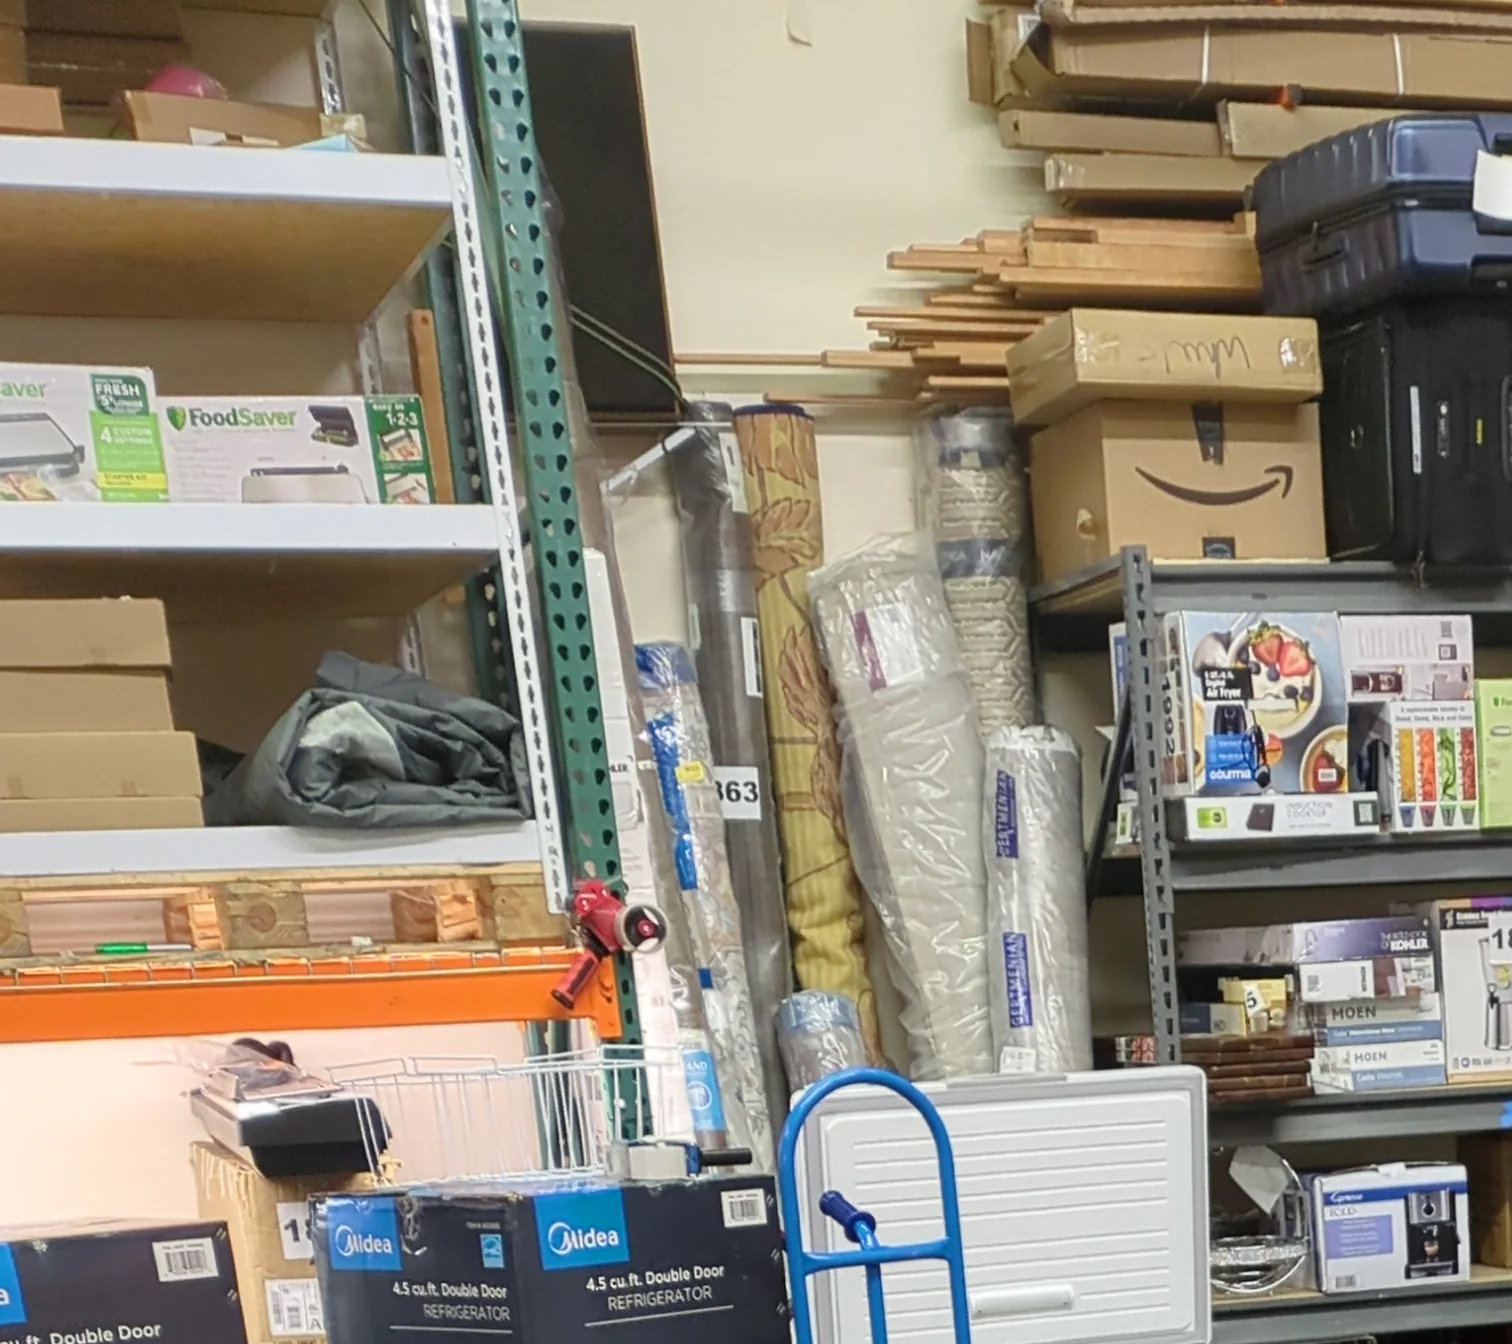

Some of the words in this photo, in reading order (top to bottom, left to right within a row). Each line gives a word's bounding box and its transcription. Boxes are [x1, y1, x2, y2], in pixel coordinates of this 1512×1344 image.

[0, 382, 47, 397] aver
[95, 383, 140, 397] FRESH
[189, 406, 297, 427] FoodSaver
[1390, 938, 1430, 951] KOHLER
[1004, 932, 1024, 1027] GERTMENIAN
[1246, 990, 1257, 1008] 5
[1331, 1005, 1377, 1020] MOEN
[1354, 1051, 1388, 1062] MOEN
[335, 1224, 393, 1257] Midea
[548, 1221, 620, 1256] Midea
[586, 1276, 606, 1292] 4.5
[646, 1268, 690, 1285] Double
[694, 1265, 725, 1279] Door
[392, 1281, 409, 1296] 4.5
[441, 1283, 478, 1298] Double
[481, 1284, 507, 1299] Door
[607, 1285, 713, 1312] REFRIGERATOR
[423, 1303, 511, 1321] REFRIGERATOR
[118, 1323, 162, 1340] Door
